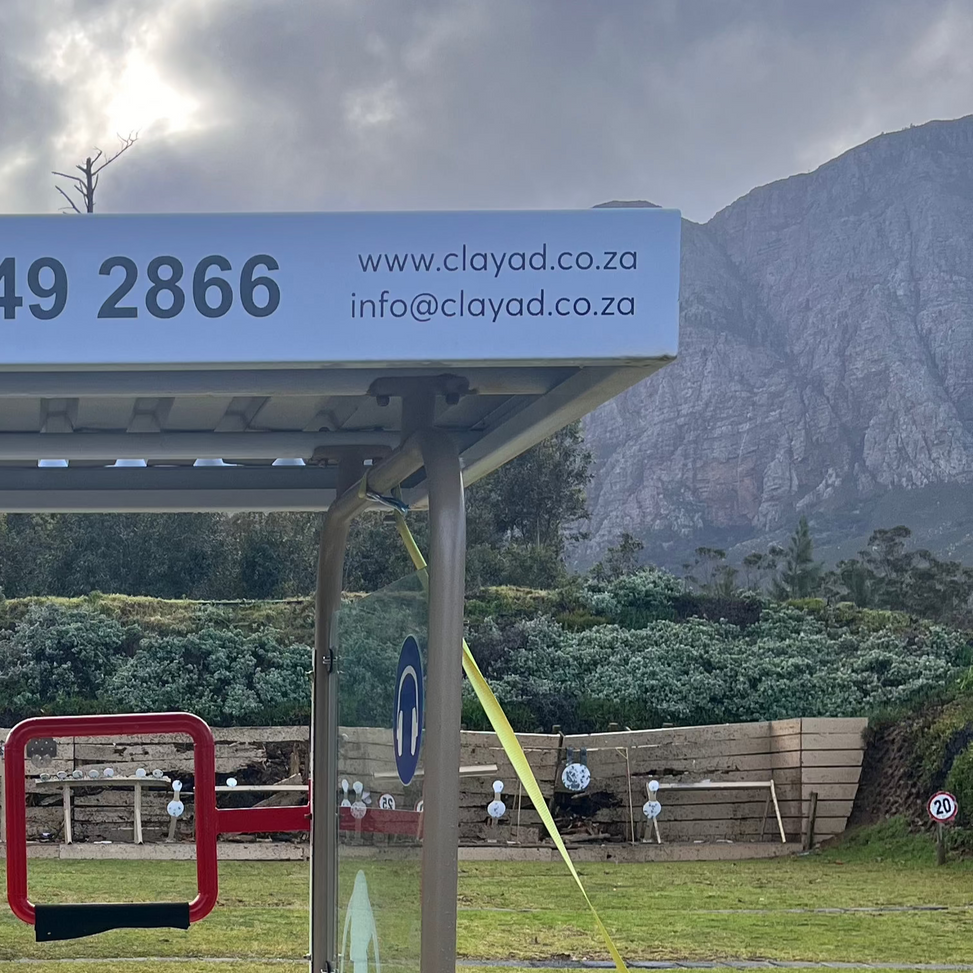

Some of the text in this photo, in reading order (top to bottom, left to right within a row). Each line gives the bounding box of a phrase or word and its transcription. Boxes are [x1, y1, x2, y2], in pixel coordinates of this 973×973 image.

[357, 243, 638, 278] www.clayad.co.za
[96, 254, 281, 319] 2866
[350, 289, 636, 323] info@clayad.co.za
[934, 798, 951, 815] 20
